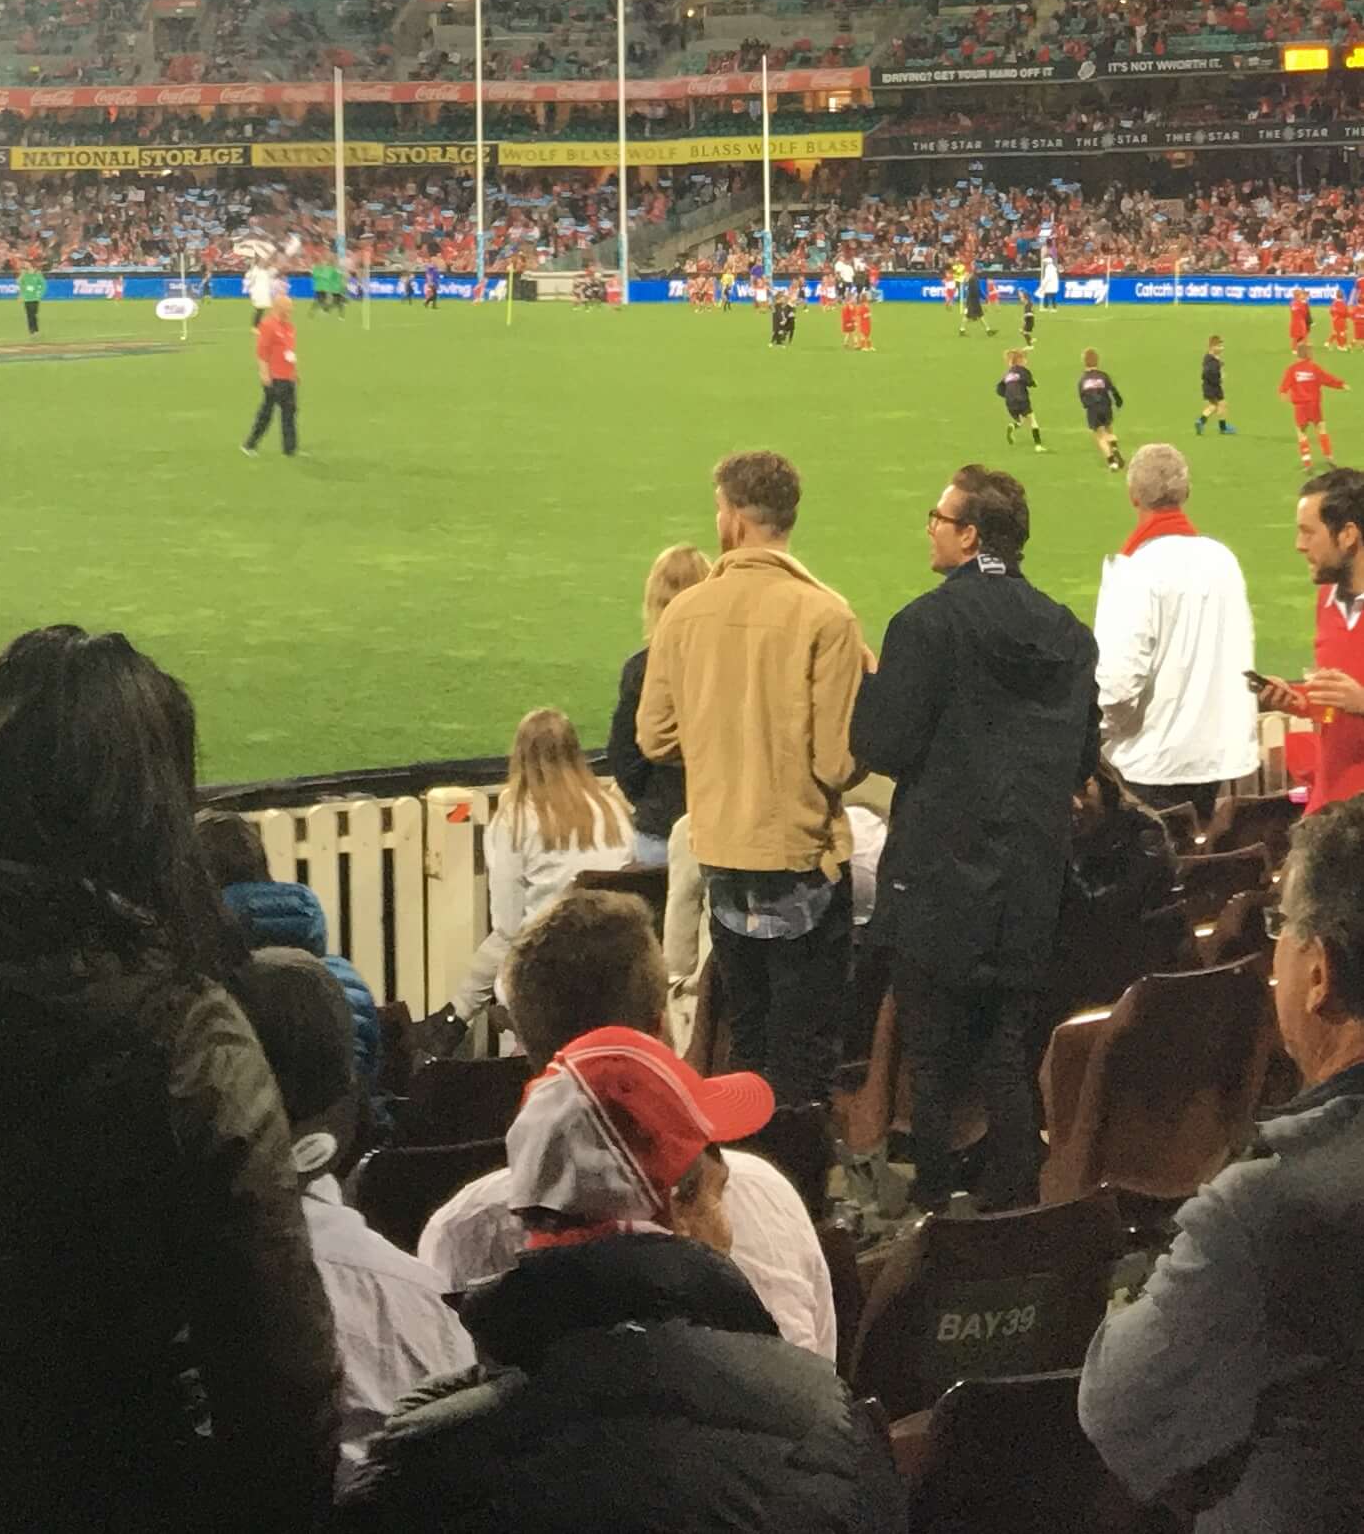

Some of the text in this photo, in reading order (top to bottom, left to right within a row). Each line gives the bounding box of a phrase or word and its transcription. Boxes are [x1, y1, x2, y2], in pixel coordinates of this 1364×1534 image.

[1019, 67, 1041, 77] OFF
[1042, 66, 1055, 76] IT
[1131, 61, 1153, 71] NOT
[94, 88, 138, 106] Coca-Cola
[1208, 131, 1240, 140] STAR
[1258, 128, 1328, 139] THE STAR
[806, 139, 859, 154] BLASS
[913, 140, 983, 151] THE STAR
[1032, 138, 1063, 148] STAR
[1076, 134, 1148, 147] THE STAR
[23, 147, 243, 168] NATIONAL STORAGE
[502, 148, 557, 161] WOLF
[627, 143, 741, 161] WOLF BLASS
[1064, 279, 1109, 305] Thrifty
[1185, 283, 1210, 297] deal
[1211, 286, 1224, 297] on
[1225, 286, 1246, 298] car
[1247, 283, 1272, 298] and
